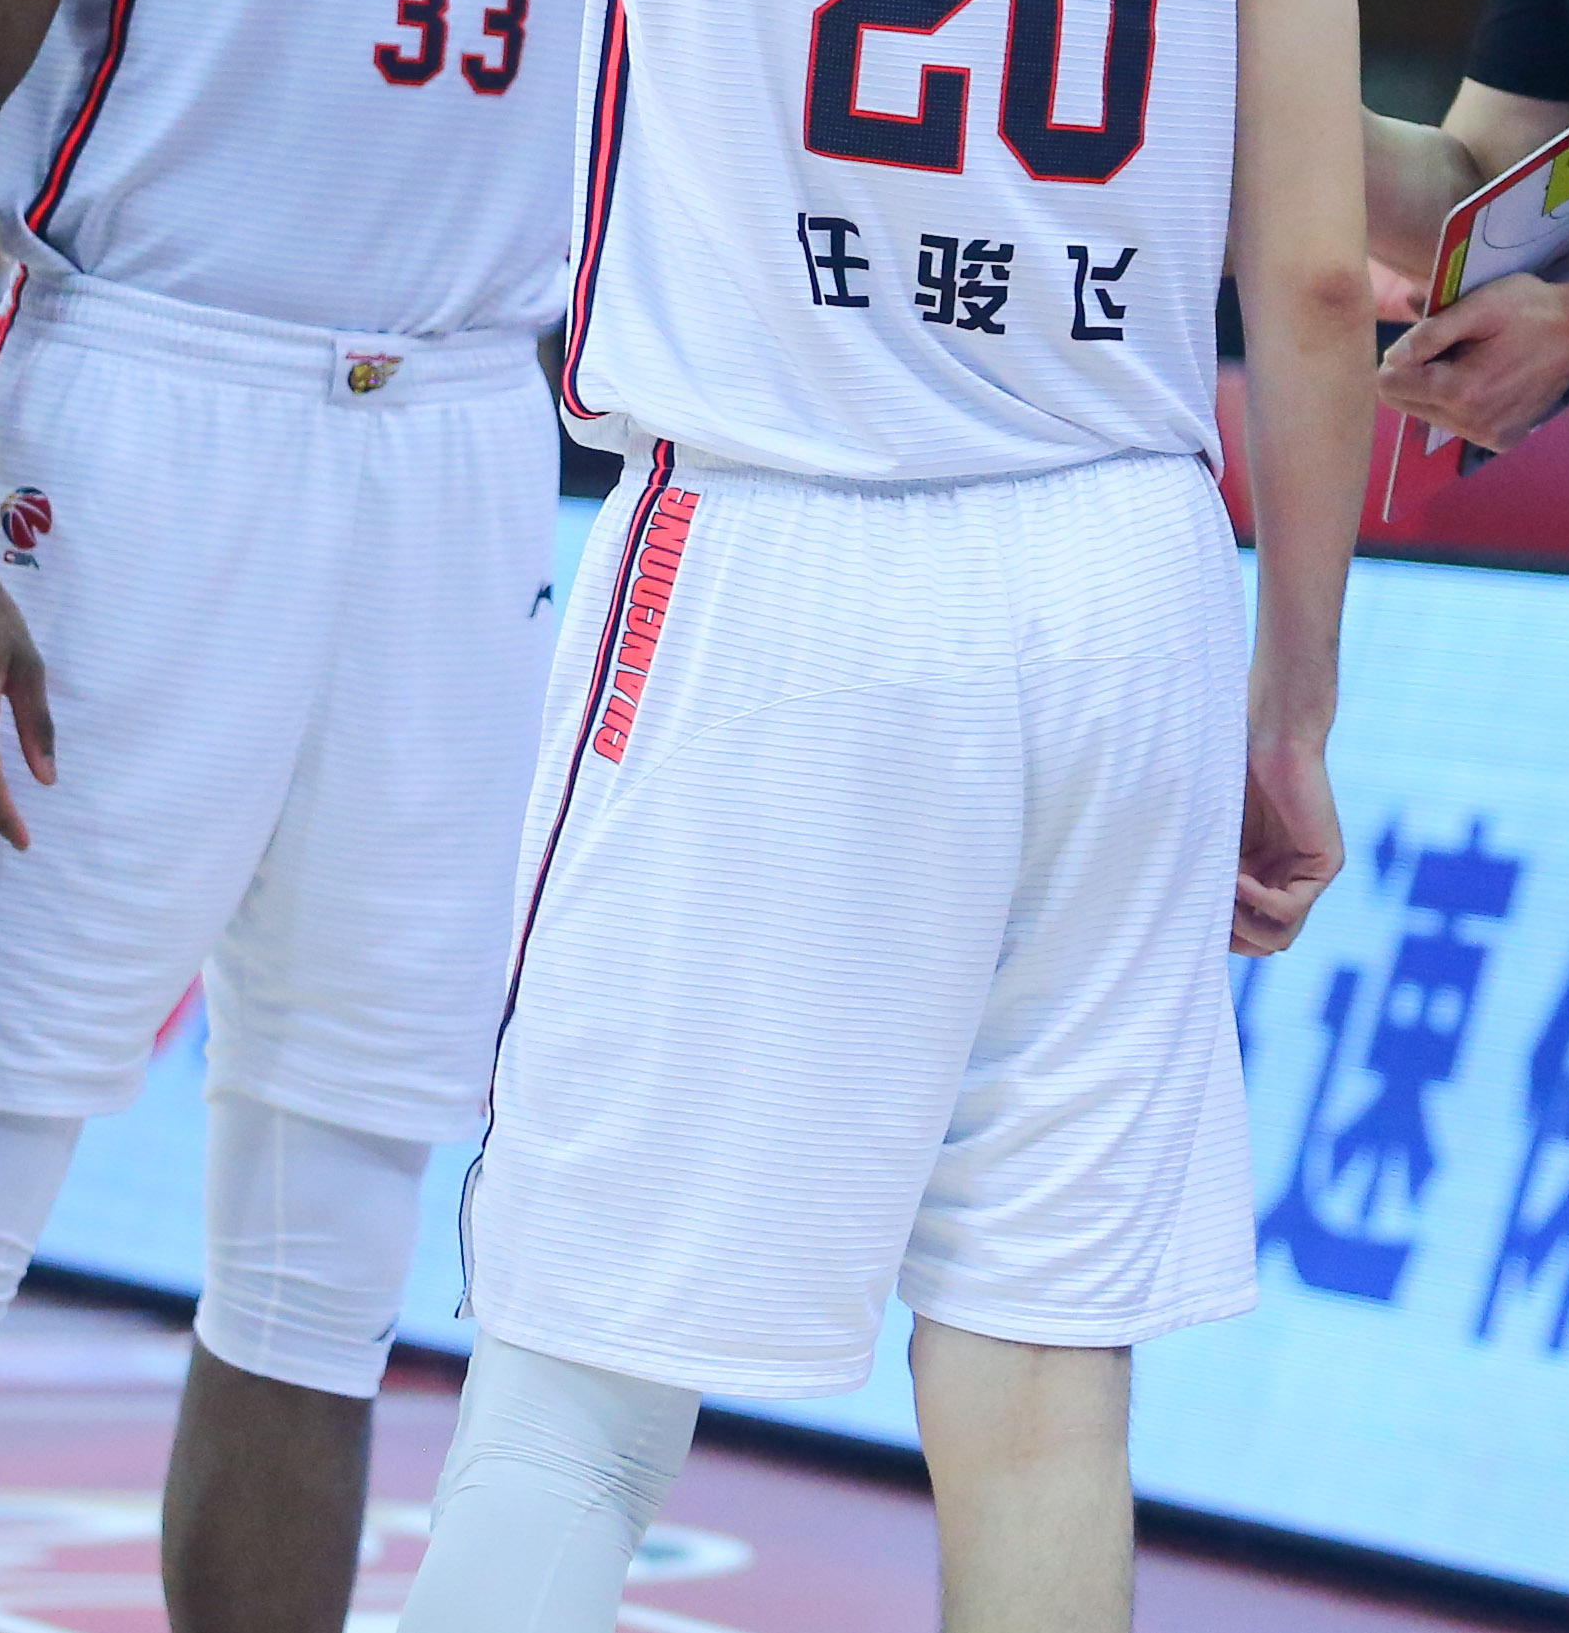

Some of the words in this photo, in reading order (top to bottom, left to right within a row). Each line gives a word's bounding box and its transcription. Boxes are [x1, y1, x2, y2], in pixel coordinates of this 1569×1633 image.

[797, 213, 1138, 340] 任骏飞
[593, 487, 702, 765] GUANGDONG
